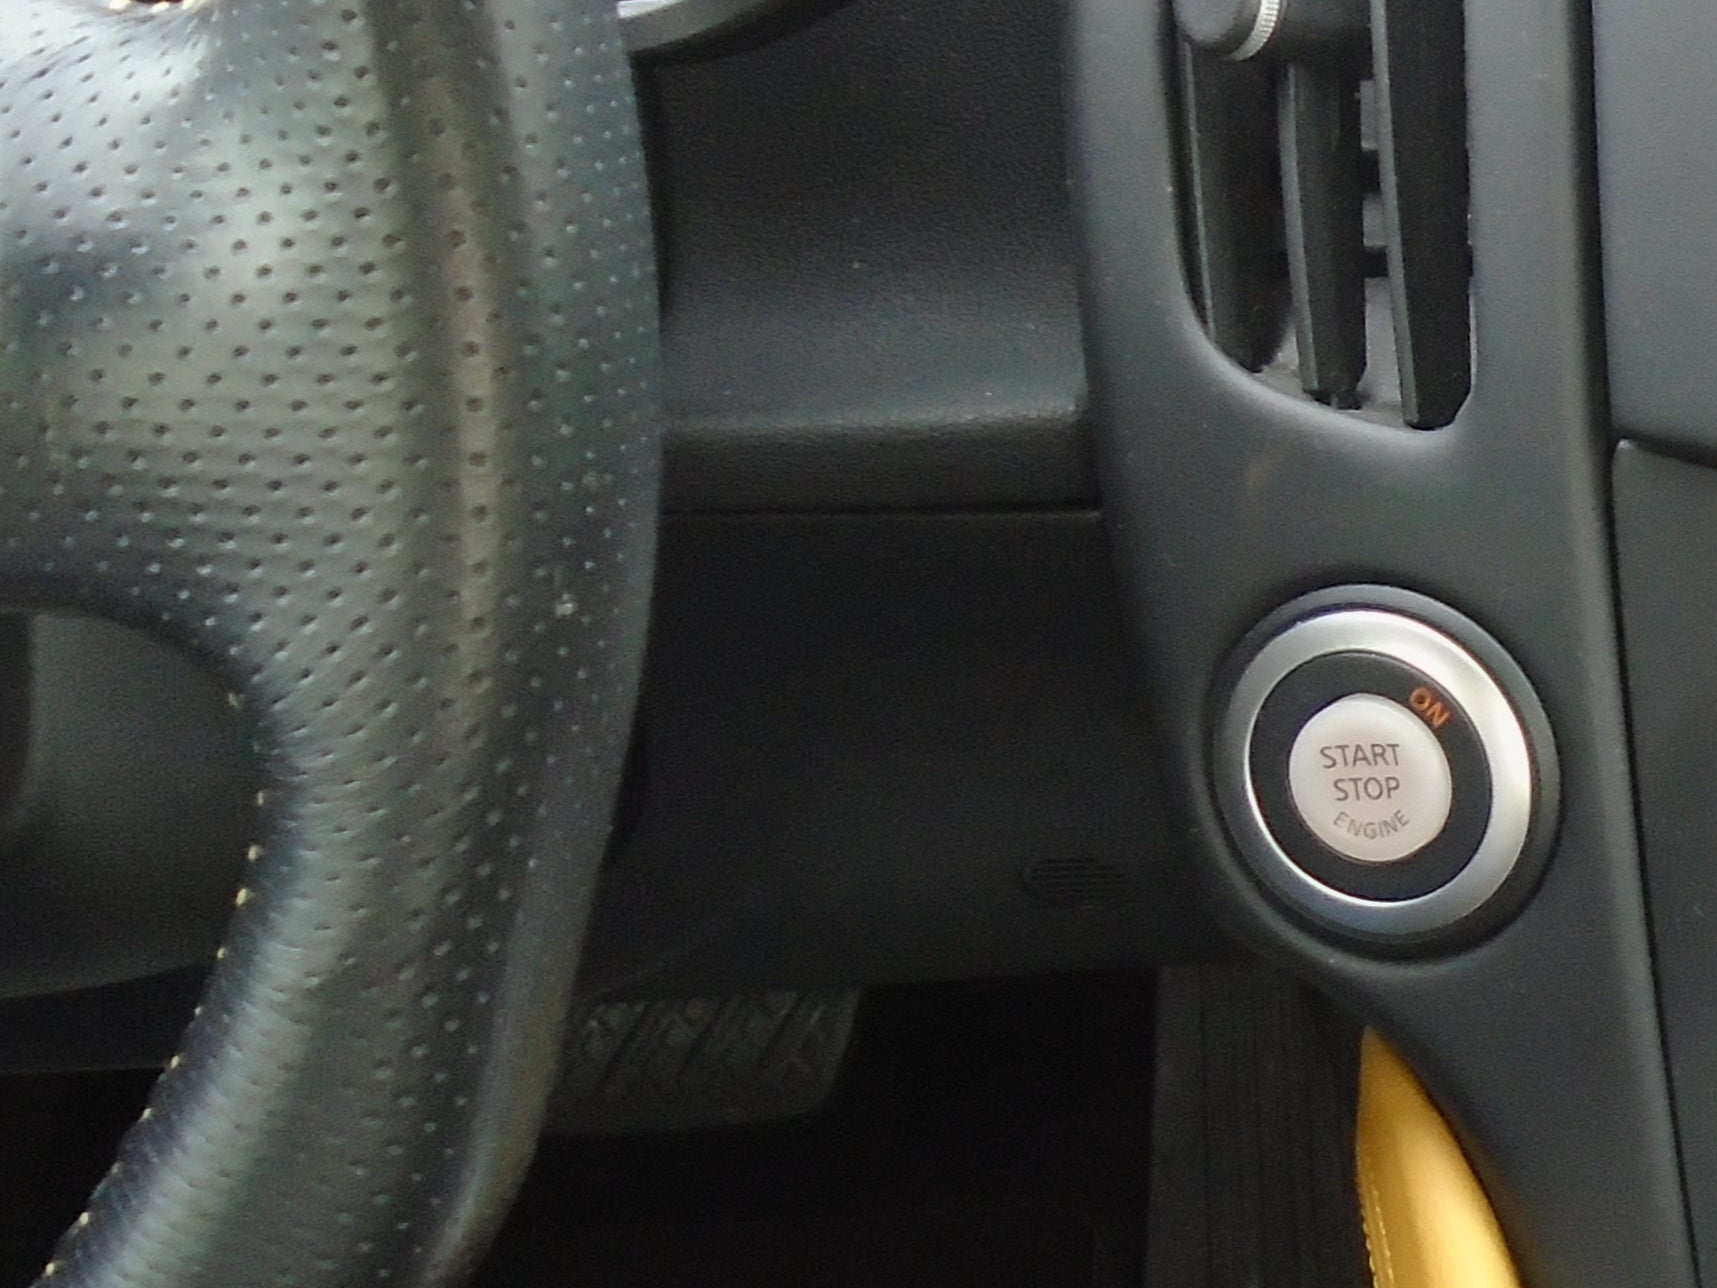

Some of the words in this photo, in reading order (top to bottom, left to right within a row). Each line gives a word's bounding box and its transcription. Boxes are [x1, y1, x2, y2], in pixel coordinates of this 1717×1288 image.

[1410, 687, 1450, 728] ON
[1320, 744, 1400, 769] START
[1334, 776, 1400, 802] STOP
[1333, 809, 1410, 839] ENGINE
